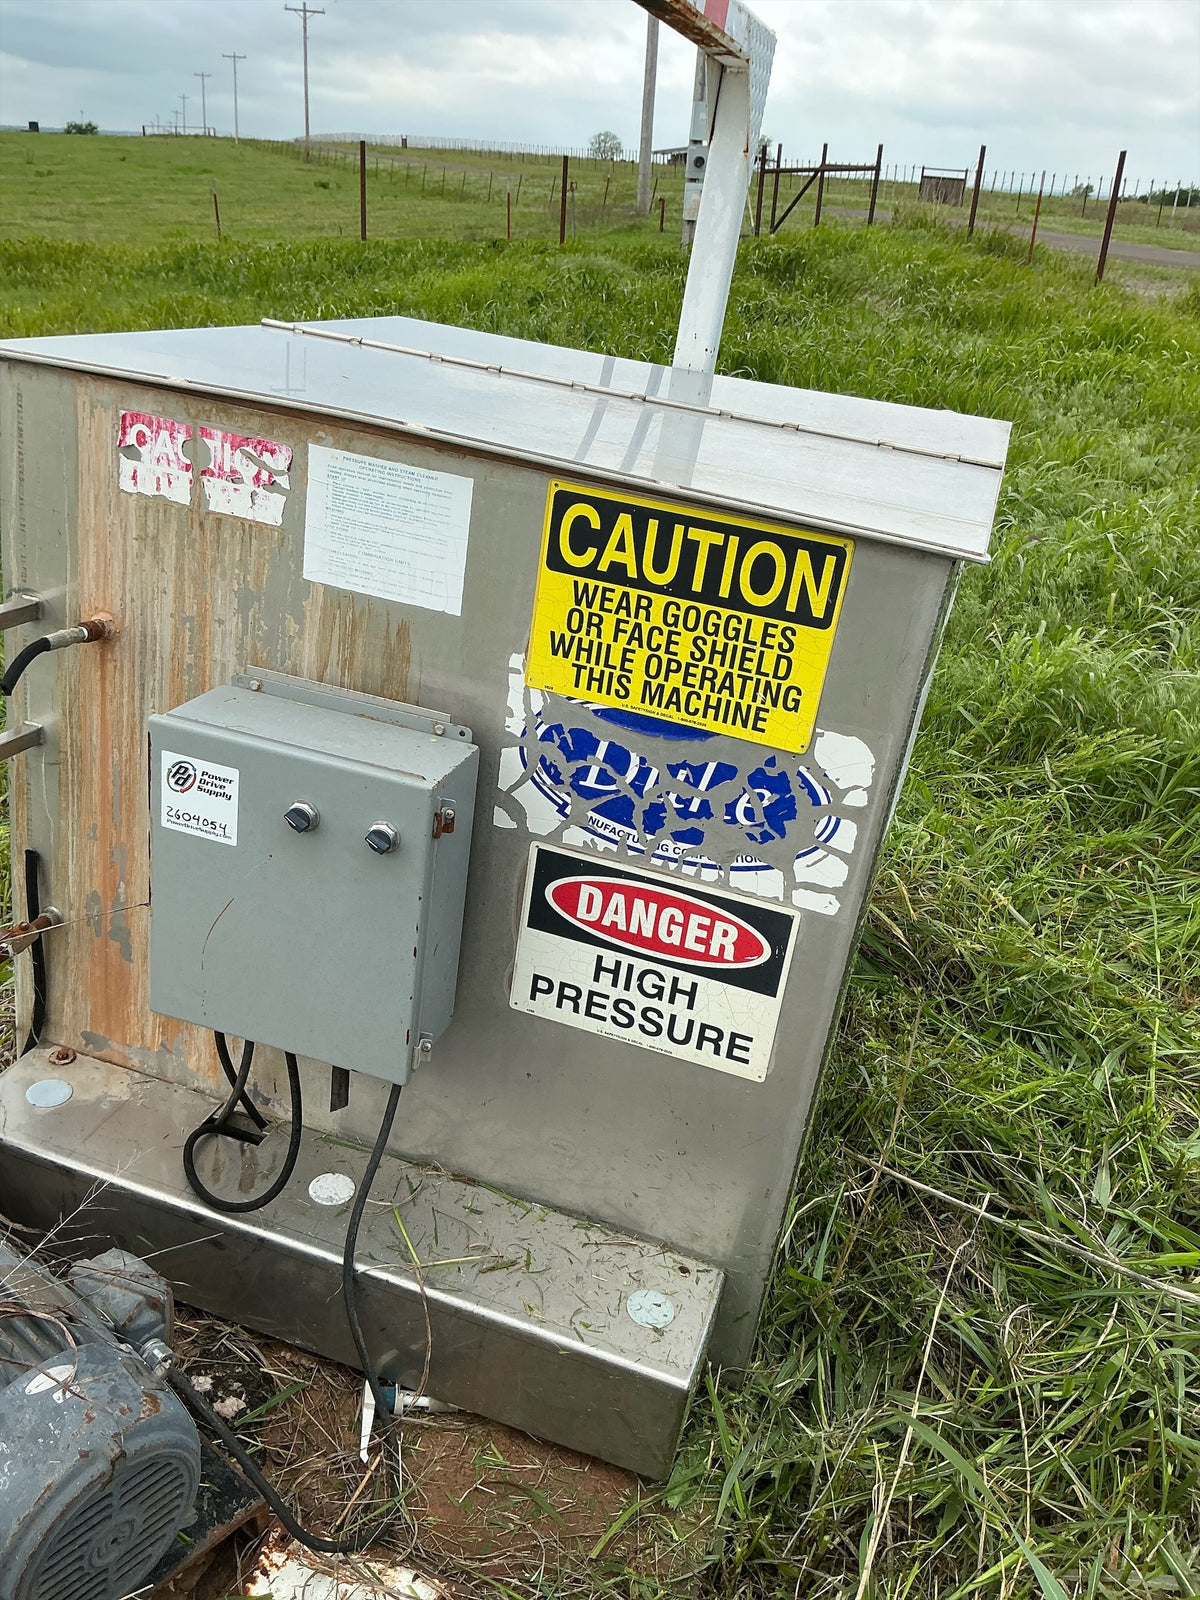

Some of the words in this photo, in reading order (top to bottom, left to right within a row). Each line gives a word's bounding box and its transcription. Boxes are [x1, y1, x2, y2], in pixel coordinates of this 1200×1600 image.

[559, 503, 837, 619] CAUTION
[566, 608, 603, 639] OR
[613, 619, 681, 656] FACE
[689, 636, 792, 681] SHIELD
[573, 580, 653, 622] WEAR
[663, 601, 797, 653] GOGGLES
[550, 631, 636, 675] WHILE
[644, 654, 802, 713] OPERATING
[571, 663, 632, 700] THIS
[640, 681, 769, 733] MACHINE
[197, 785, 232, 801] Supply
[199, 778, 226, 790] Drive
[201, 770, 234, 784] Power
[166, 805, 228, 836] 2604054
[576, 883, 739, 961] DANGER
[592, 954, 698, 1010] HIGH
[529, 973, 753, 1064] PRESSURE
